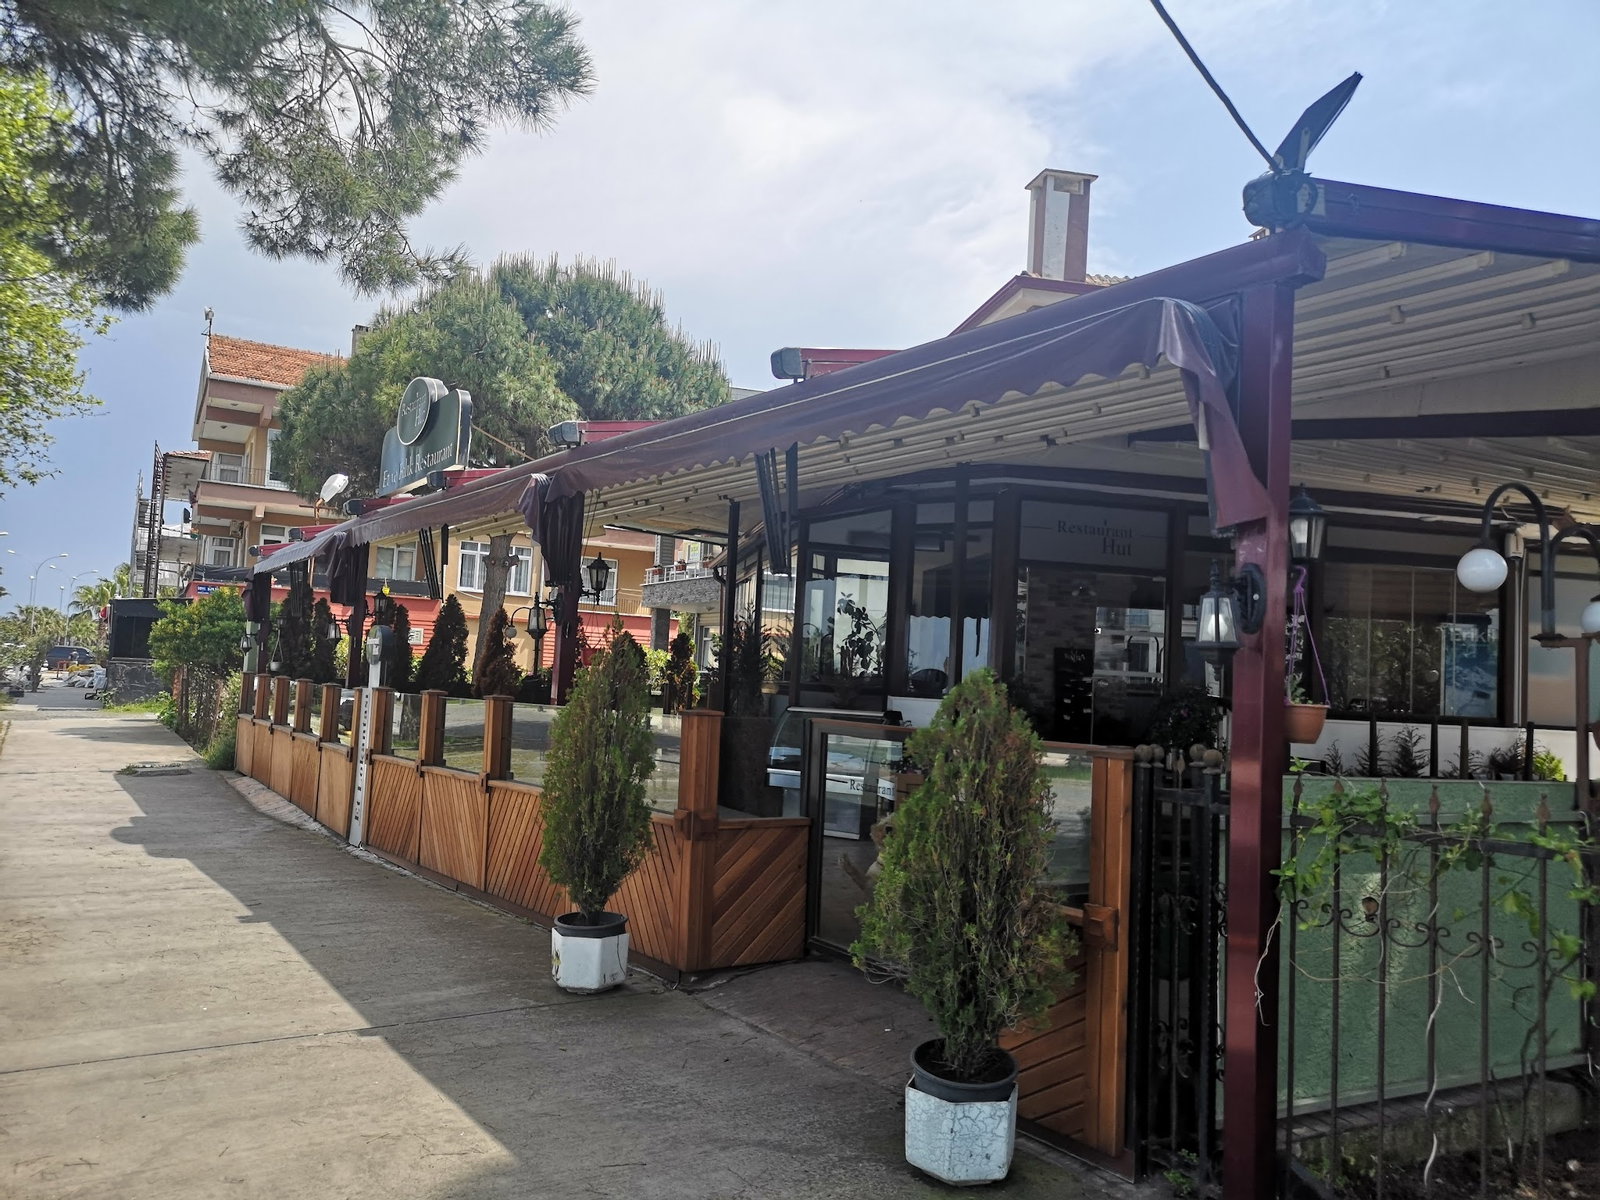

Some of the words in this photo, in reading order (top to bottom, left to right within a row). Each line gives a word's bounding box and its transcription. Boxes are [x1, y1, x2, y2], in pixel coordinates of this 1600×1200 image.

[415, 443, 453, 473] Restaurant
[1057, 520, 1133, 538] Restaurant
[1101, 537, 1132, 556] Hut
